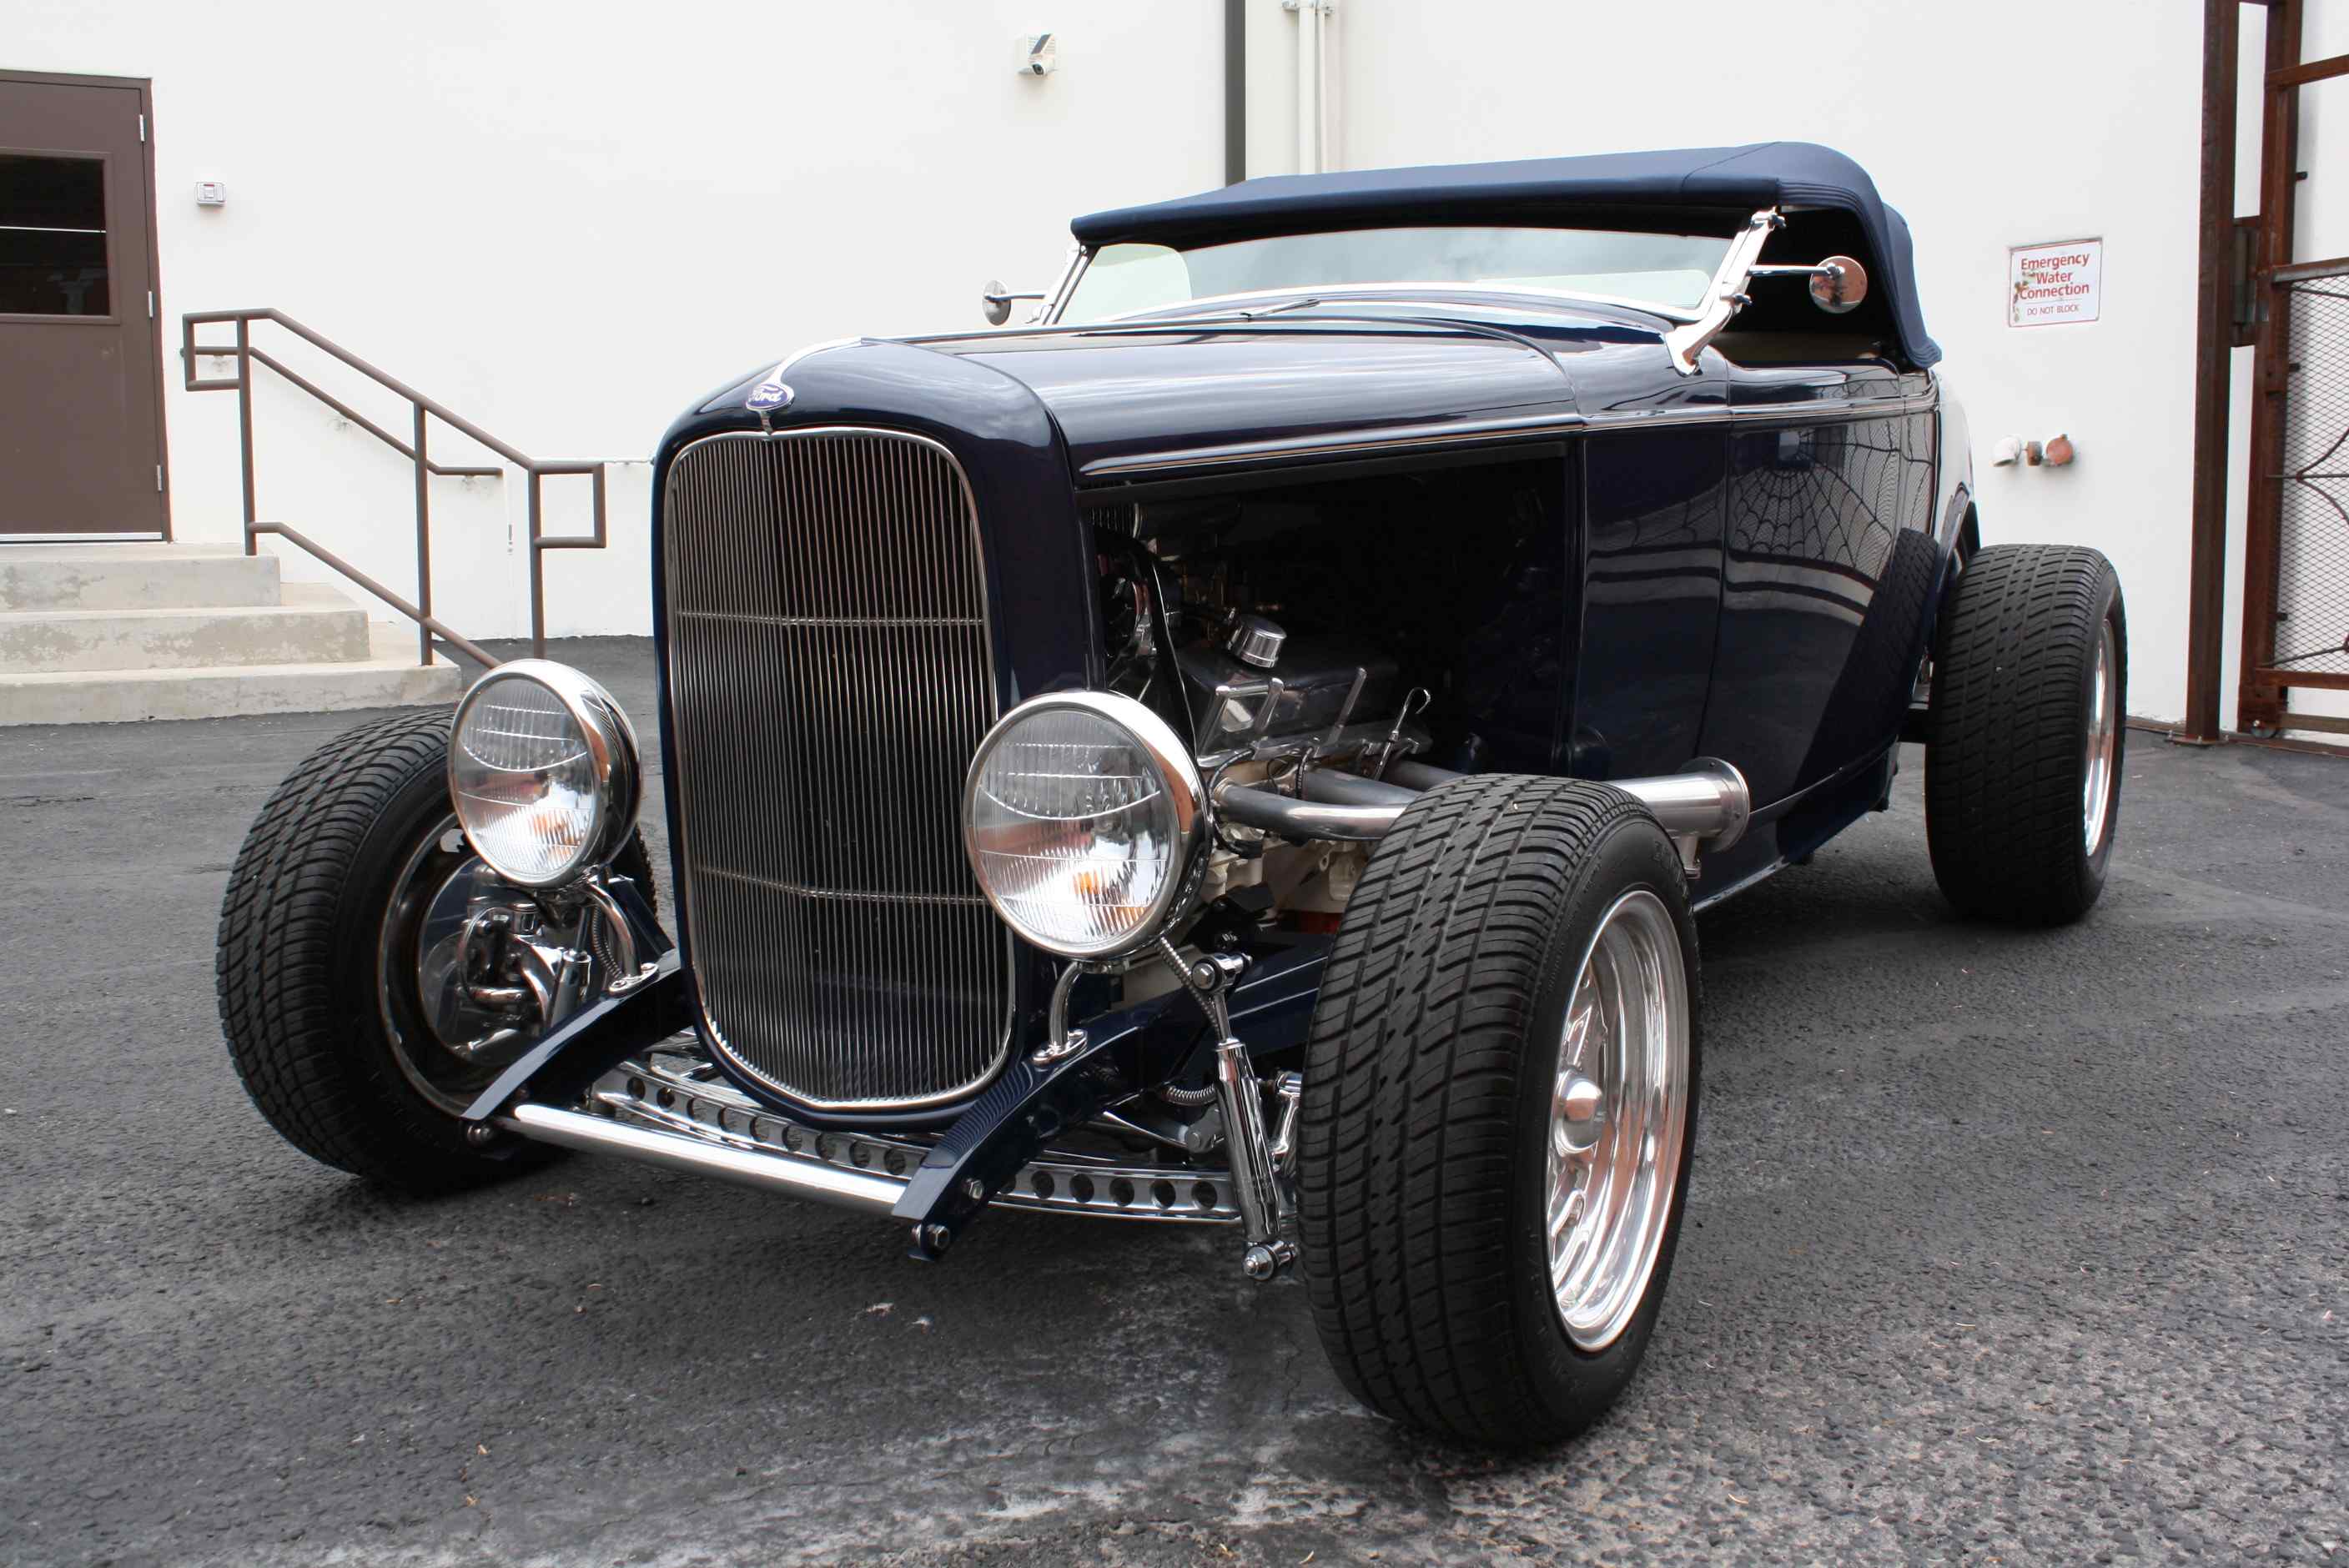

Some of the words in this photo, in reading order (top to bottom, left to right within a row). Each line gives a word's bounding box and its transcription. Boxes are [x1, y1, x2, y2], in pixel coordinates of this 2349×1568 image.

[2021, 254, 2090, 270] Emergency
[2035, 272, 2073, 284] Water
[2020, 282, 2090, 299] Connection
[2027, 307, 2037, 315] DO
[2040, 306, 2054, 314] NOT
[2056, 304, 2080, 314] BLOCK
